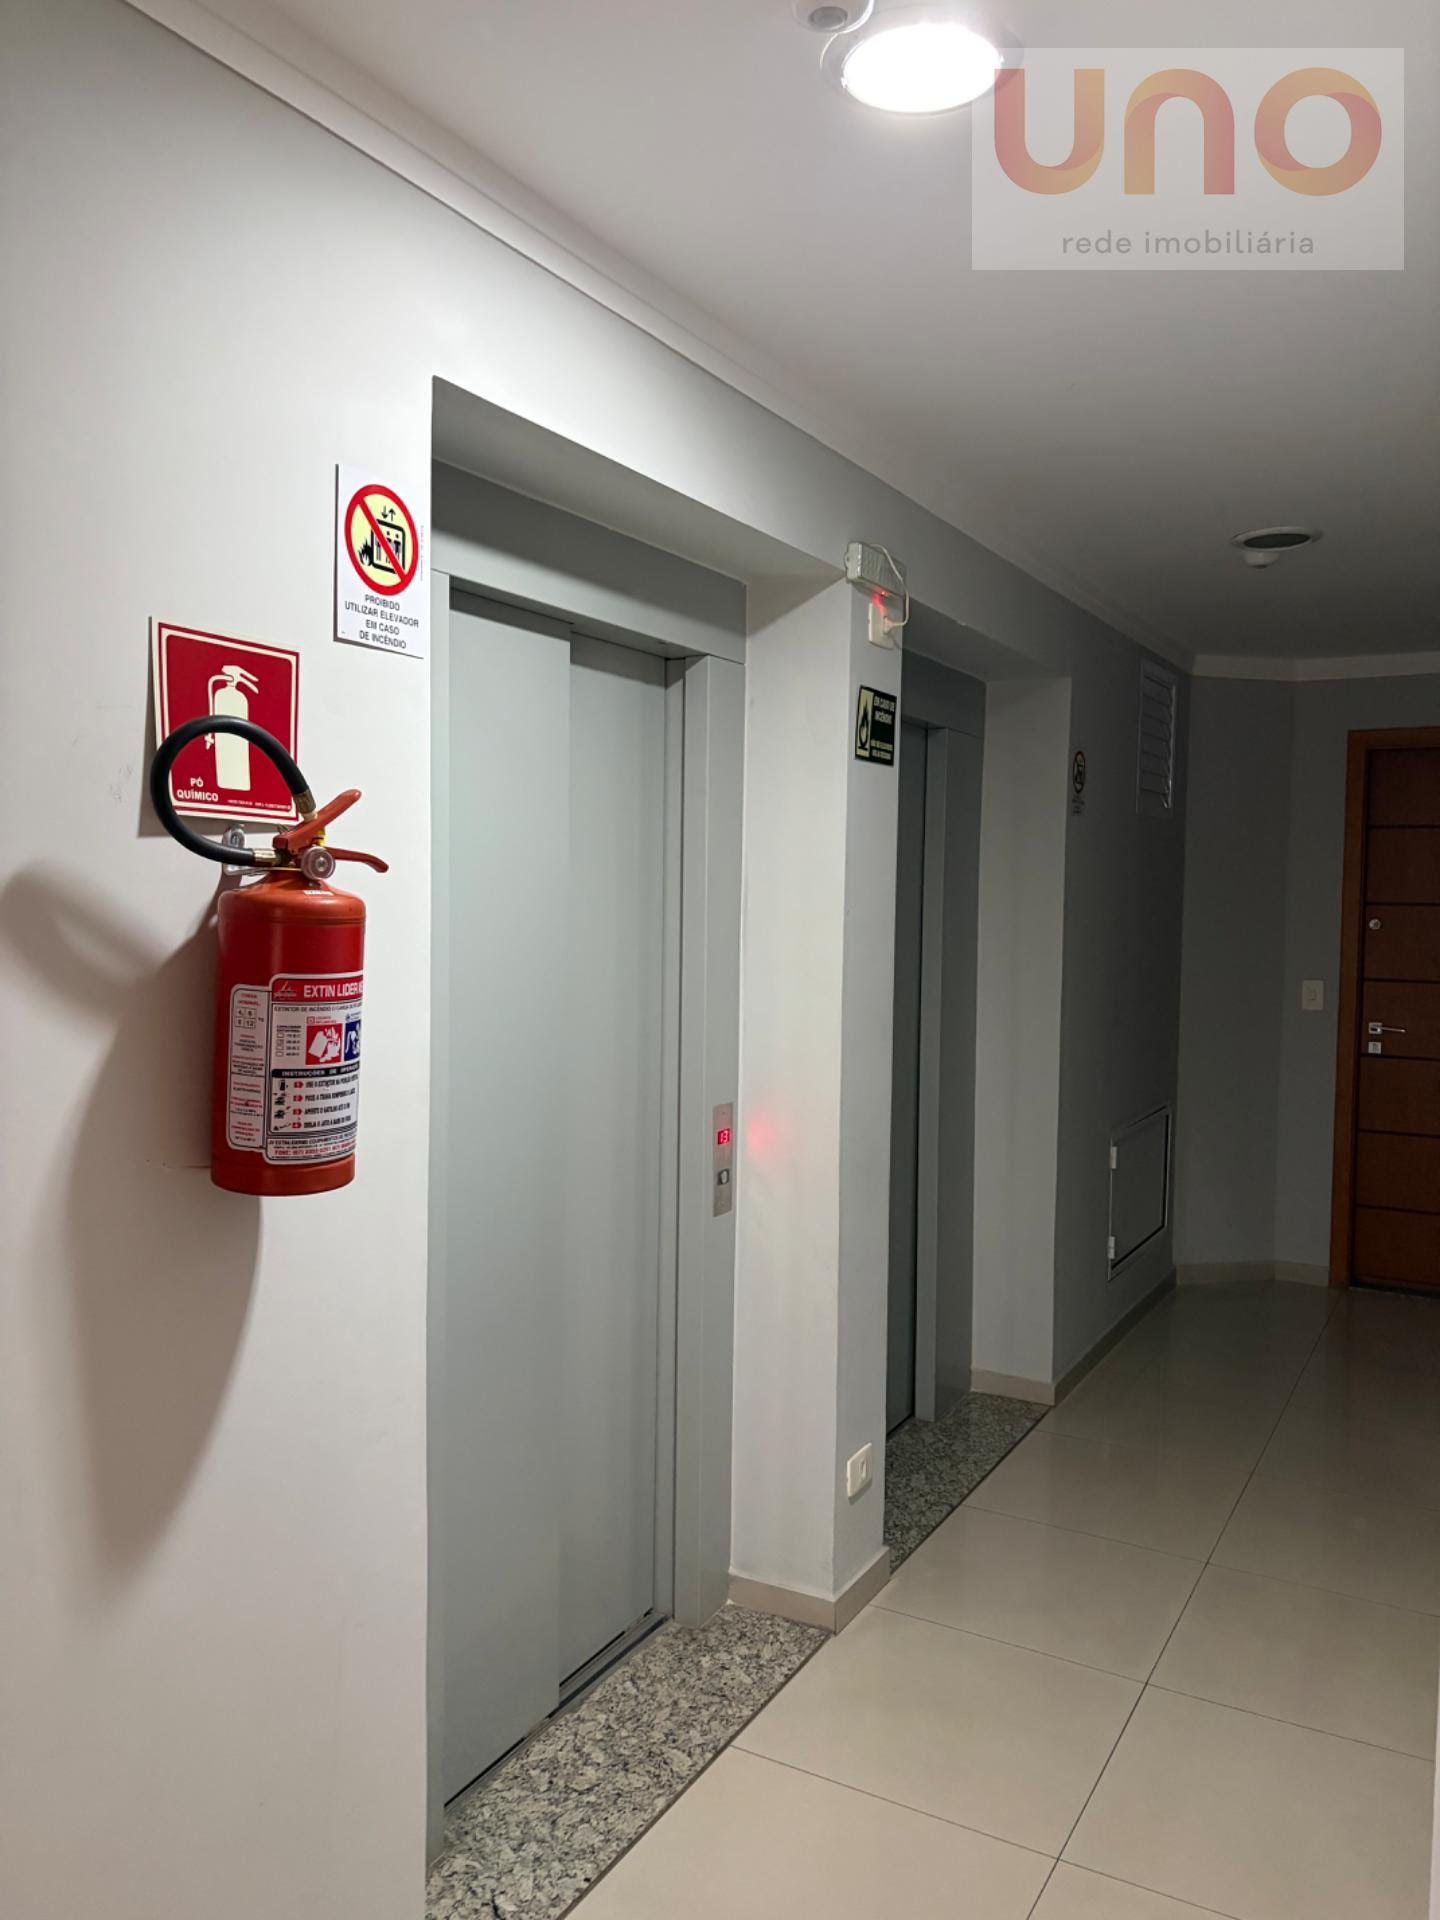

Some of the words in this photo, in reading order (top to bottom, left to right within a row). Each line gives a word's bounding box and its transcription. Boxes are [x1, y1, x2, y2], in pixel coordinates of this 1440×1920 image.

[364, 594, 400, 611] PROIBIDO
[344, 601, 378, 617] UTILIZAR
[380, 610, 419, 628] ELEVADOR
[365, 619, 377, 629] EM
[379, 623, 400, 636] CASO
[359, 630, 370, 641] DE
[372, 633, 407, 649] INCÊNDIO
[190, 776, 204, 788] PÓ
[176, 788, 219, 802] QUÍMICO
[303, 984, 336, 998] EXTIN
[720, 1130, 729, 1143] 13
